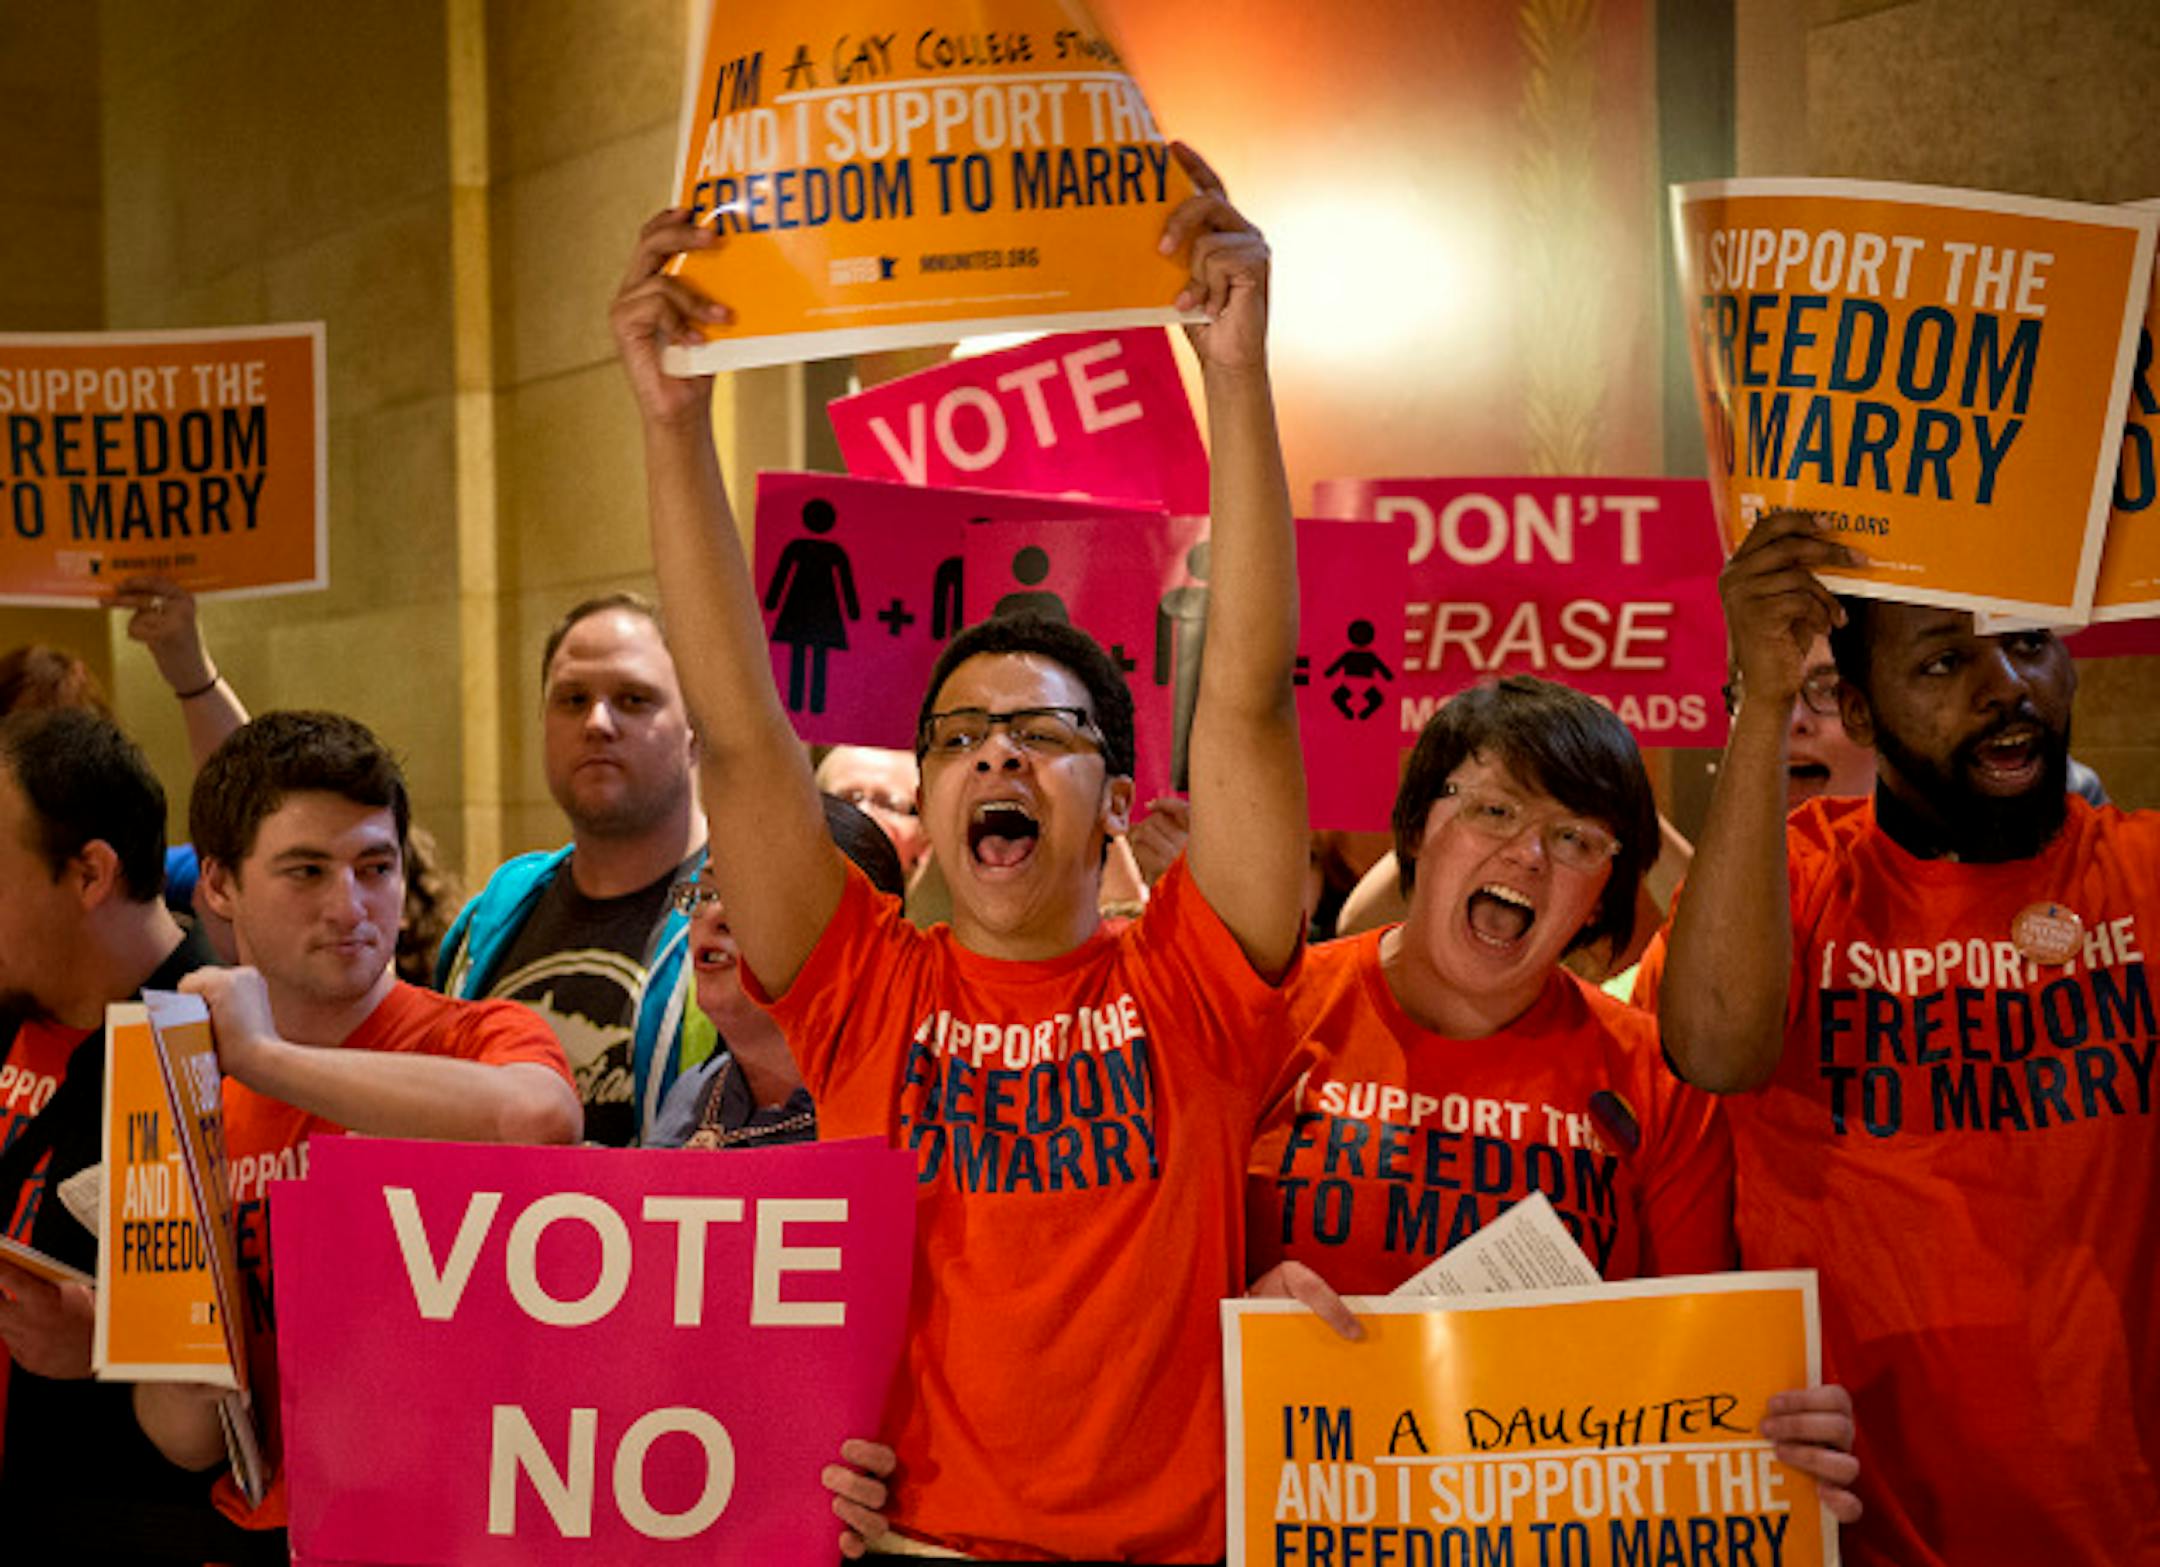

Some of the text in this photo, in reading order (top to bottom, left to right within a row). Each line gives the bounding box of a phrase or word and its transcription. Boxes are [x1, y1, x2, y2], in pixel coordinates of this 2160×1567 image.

[713, 51, 763, 120] I'M
[781, 44, 815, 90] A
[833, 33, 896, 84] GAY
[915, 28, 1033, 70] COLLEGE
[697, 108, 778, 179] AND
[796, 101, 809, 165] I
[824, 81, 1069, 161] SUPPORT
[690, 143, 1169, 237] FREEDOM TO MARRY
[1709, 228, 1925, 300] SUPPORT
[1942, 241, 2055, 316] THE
[193, 361, 267, 408] THE
[869, 338, 1143, 487] VOTE
[8, 406, 267, 477] REEDOM
[1746, 391, 2024, 505] MARRY
[69, 473, 267, 541] MARRY
[1374, 494, 1660, 565] DON'T
[1590, 694, 1707, 732] ADS
[1820, 940, 1836, 989] I
[2064, 915, 2144, 977] HE
[1819, 961, 2159, 1066] FREEDOM
[1319, 1081, 1529, 1140] SUPPORT
[1541, 1104, 1602, 1153] TH
[1820, 1040, 2160, 1138] TO MARRY
[128, 1111, 159, 1163] I'M
[953, 1114, 1159, 1193] MARRY
[1279, 1112, 1618, 1217] FREEDOM
[122, 1164, 171, 1219] AND
[1277, 1179, 1354, 1245] TO
[122, 1221, 207, 1275] FREEDO
[383, 1186, 849, 1328] VOTE
[1283, 1393, 1752, 1461] I'M A DAUGHTER
[487, 1404, 736, 1541] NO
[1274, 1446, 1791, 1524] AND I SUPPORT THE
[1275, 1513, 1790, 1567] FREEDOM TO MARRY
